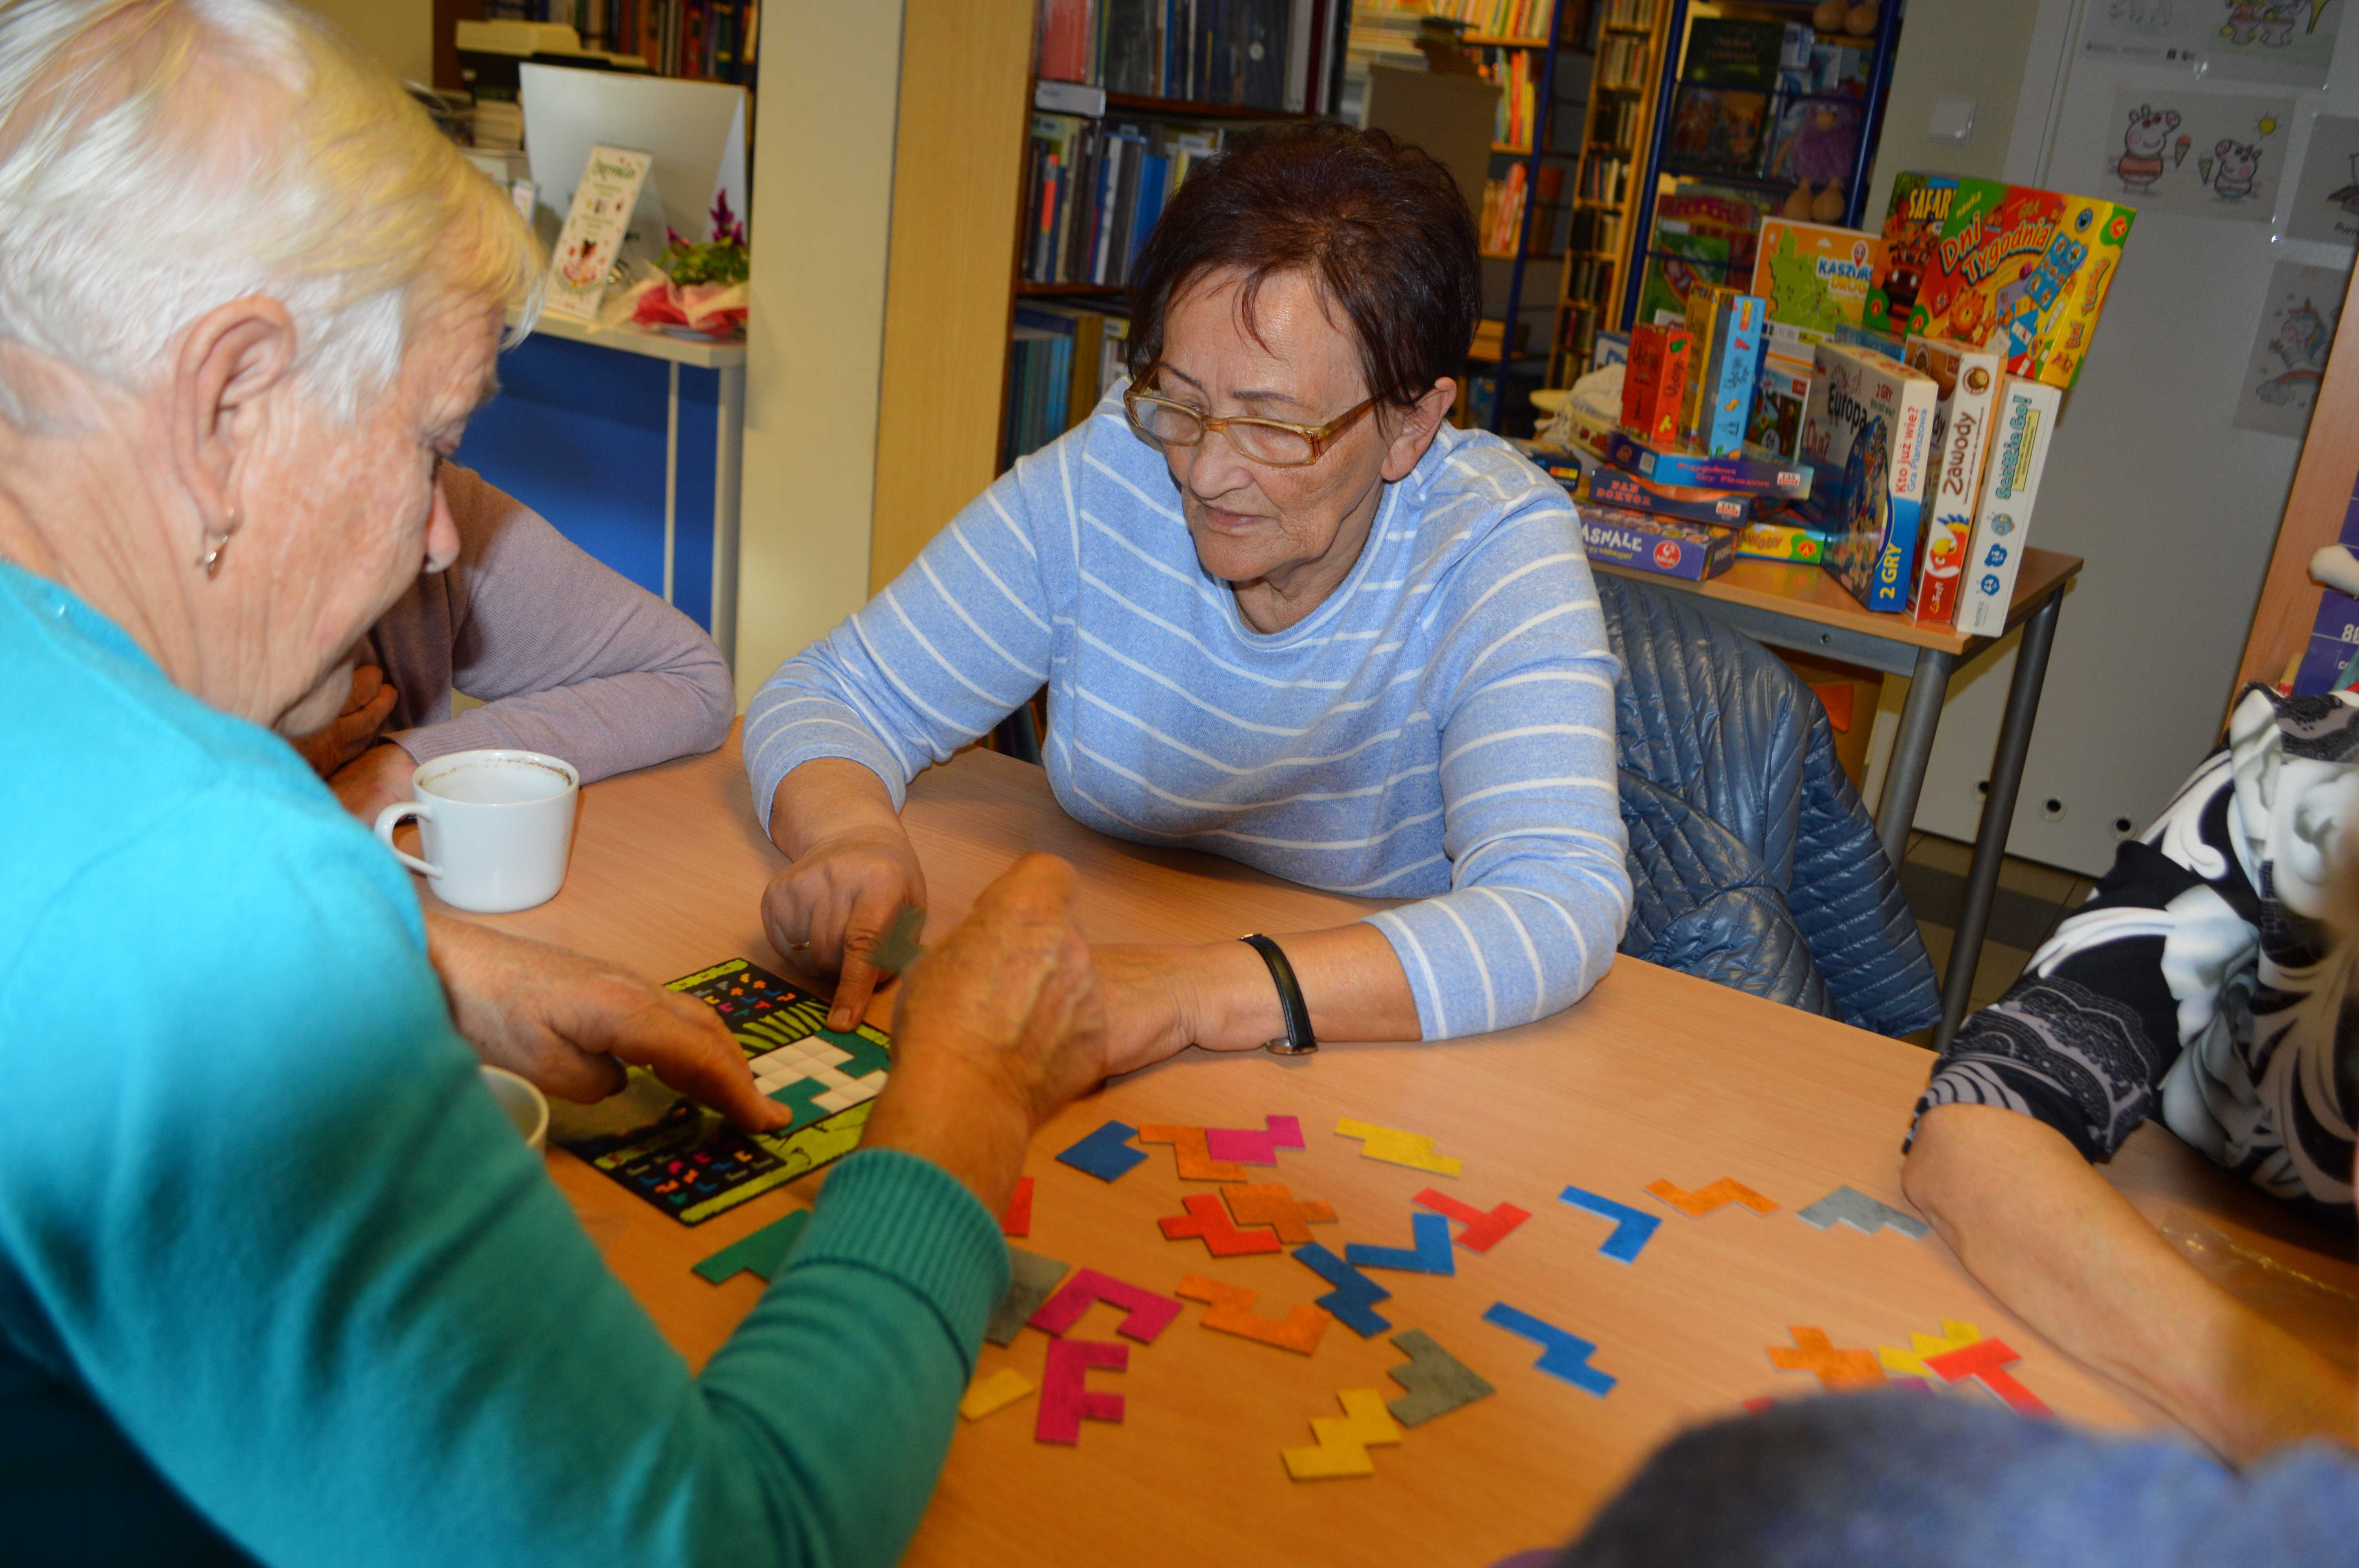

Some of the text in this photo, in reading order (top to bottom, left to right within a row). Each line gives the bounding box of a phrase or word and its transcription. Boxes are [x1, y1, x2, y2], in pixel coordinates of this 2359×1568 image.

[1940, 211, 1982, 273] Dni
[1962, 216, 2053, 284] Tygodnia
[1831, 274, 1868, 294] DROG
[2082, 258, 2109, 314] Tygodnia
[2065, 321, 2085, 348] Dni
[1827, 383, 1868, 430] Europa
[2010, 394, 2032, 428] Go!
[1895, 406, 1920, 494] Kto już wie?
[1907, 408, 1928, 493] Gra Planszowa
[1942, 411, 1977, 496] Zawody
[1996, 426, 2025, 500] Scottie
[1596, 487, 1652, 507] DOKTOR
[1612, 480, 1639, 494] PAN
[1696, 472, 1717, 483] Gry
[1581, 523, 1643, 553] ASNALE
[1739, 529, 1783, 550] AWODY
[1880, 541, 1902, 600] 2 GRY
